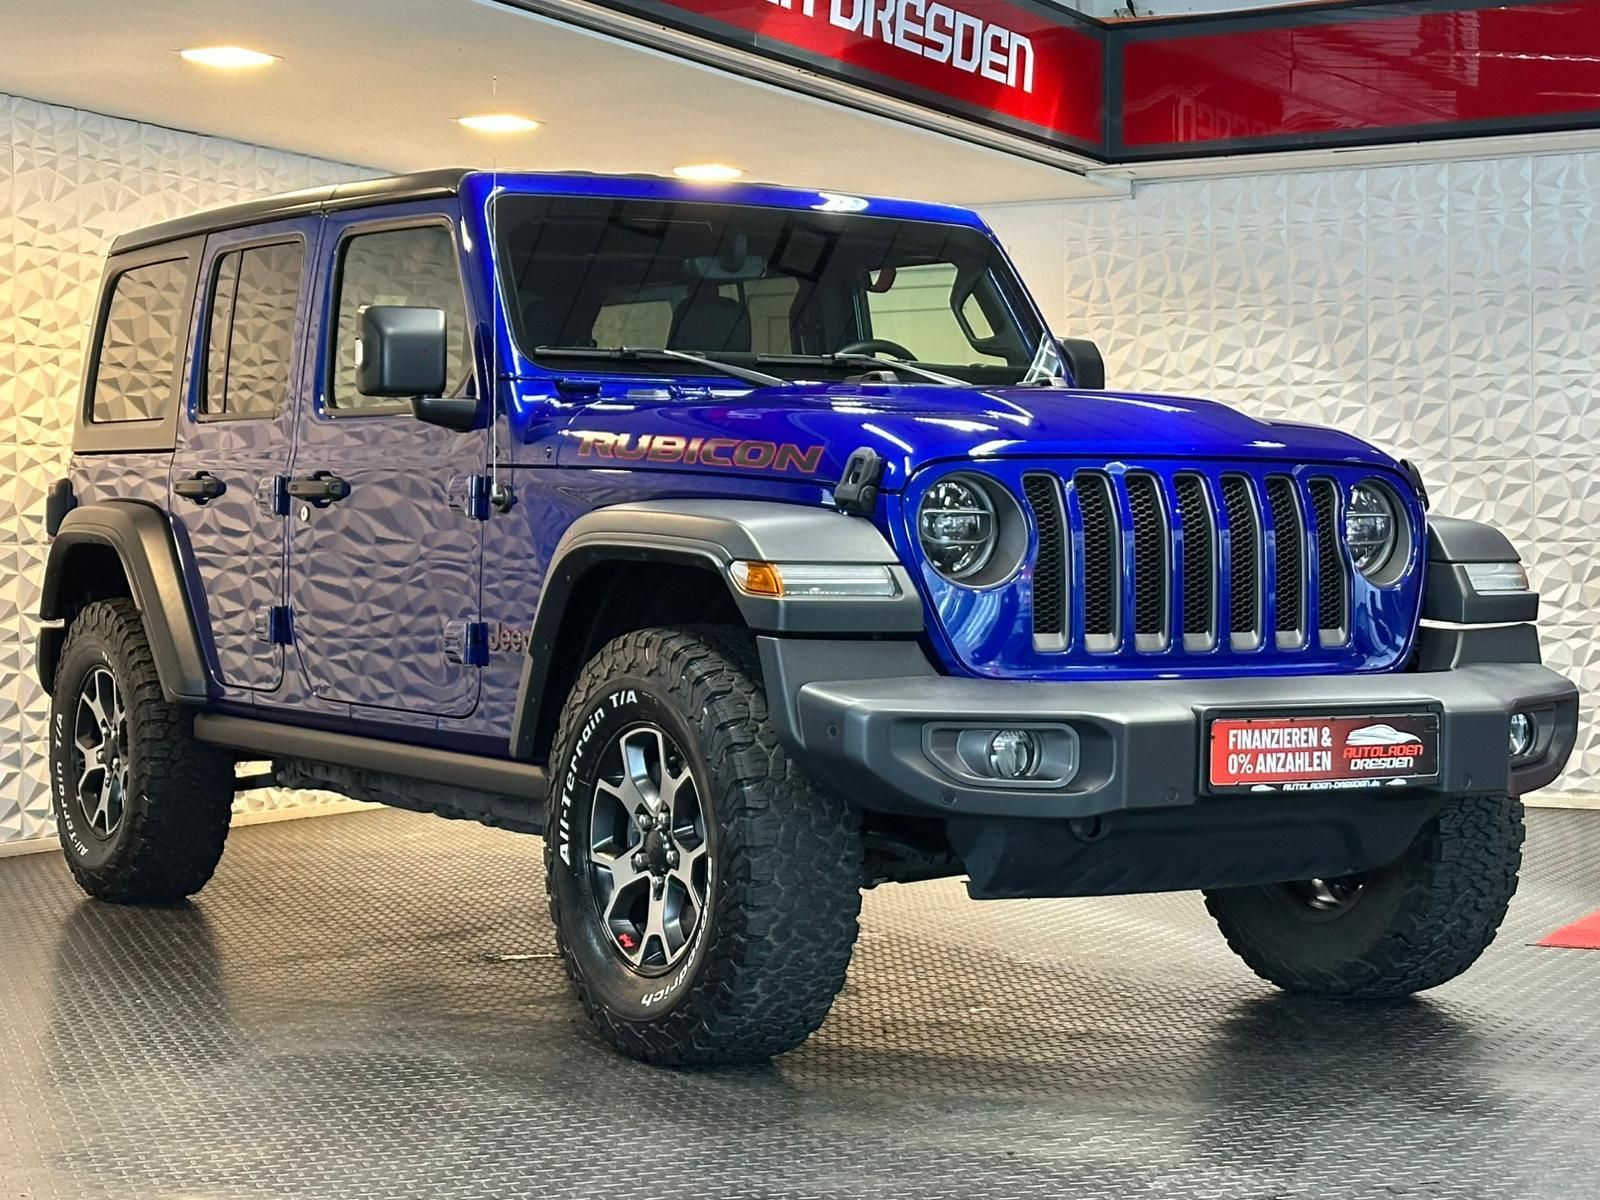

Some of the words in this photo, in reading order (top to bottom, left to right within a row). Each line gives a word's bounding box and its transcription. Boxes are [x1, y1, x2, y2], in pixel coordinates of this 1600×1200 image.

[829, 0, 1034, 93] DRESDEN
[574, 430, 825, 473] RUBICON
[1228, 727, 1318, 750] FINANZIEREN
[1321, 727, 1332, 748] &
[1227, 753, 1254, 775] 0%
[1255, 751, 1331, 774] ANZAHLEN
[1343, 744, 1424, 759] AUTOLADEN
[1350, 756, 1414, 770] DRESDEN
[559, 706, 605, 866] All-Terrain
[608, 690, 638, 708] T/A
